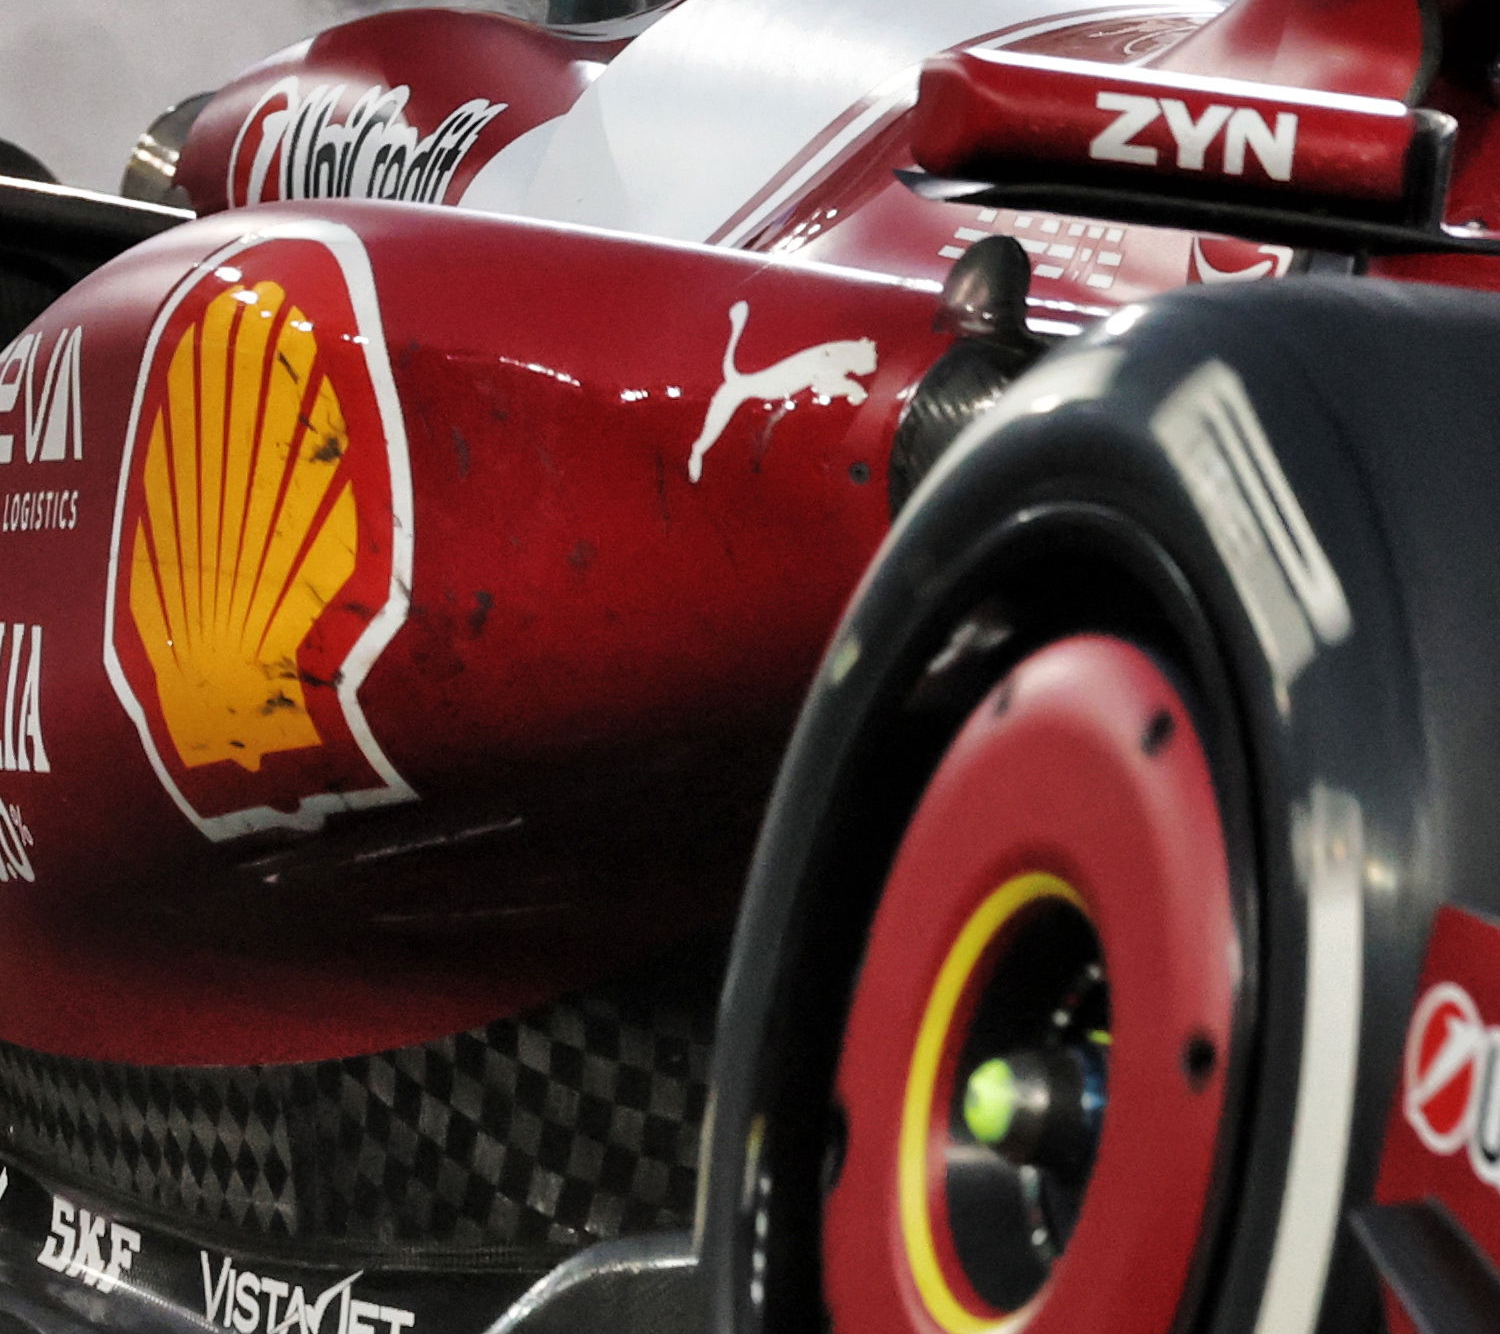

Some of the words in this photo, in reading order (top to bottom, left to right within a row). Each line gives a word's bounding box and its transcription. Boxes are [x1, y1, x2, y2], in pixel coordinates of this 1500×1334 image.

[1090, 91, 1298, 182] ZYN
[2, 490, 79, 533] LOGISTICS
[37, 1194, 142, 1294] SKF
